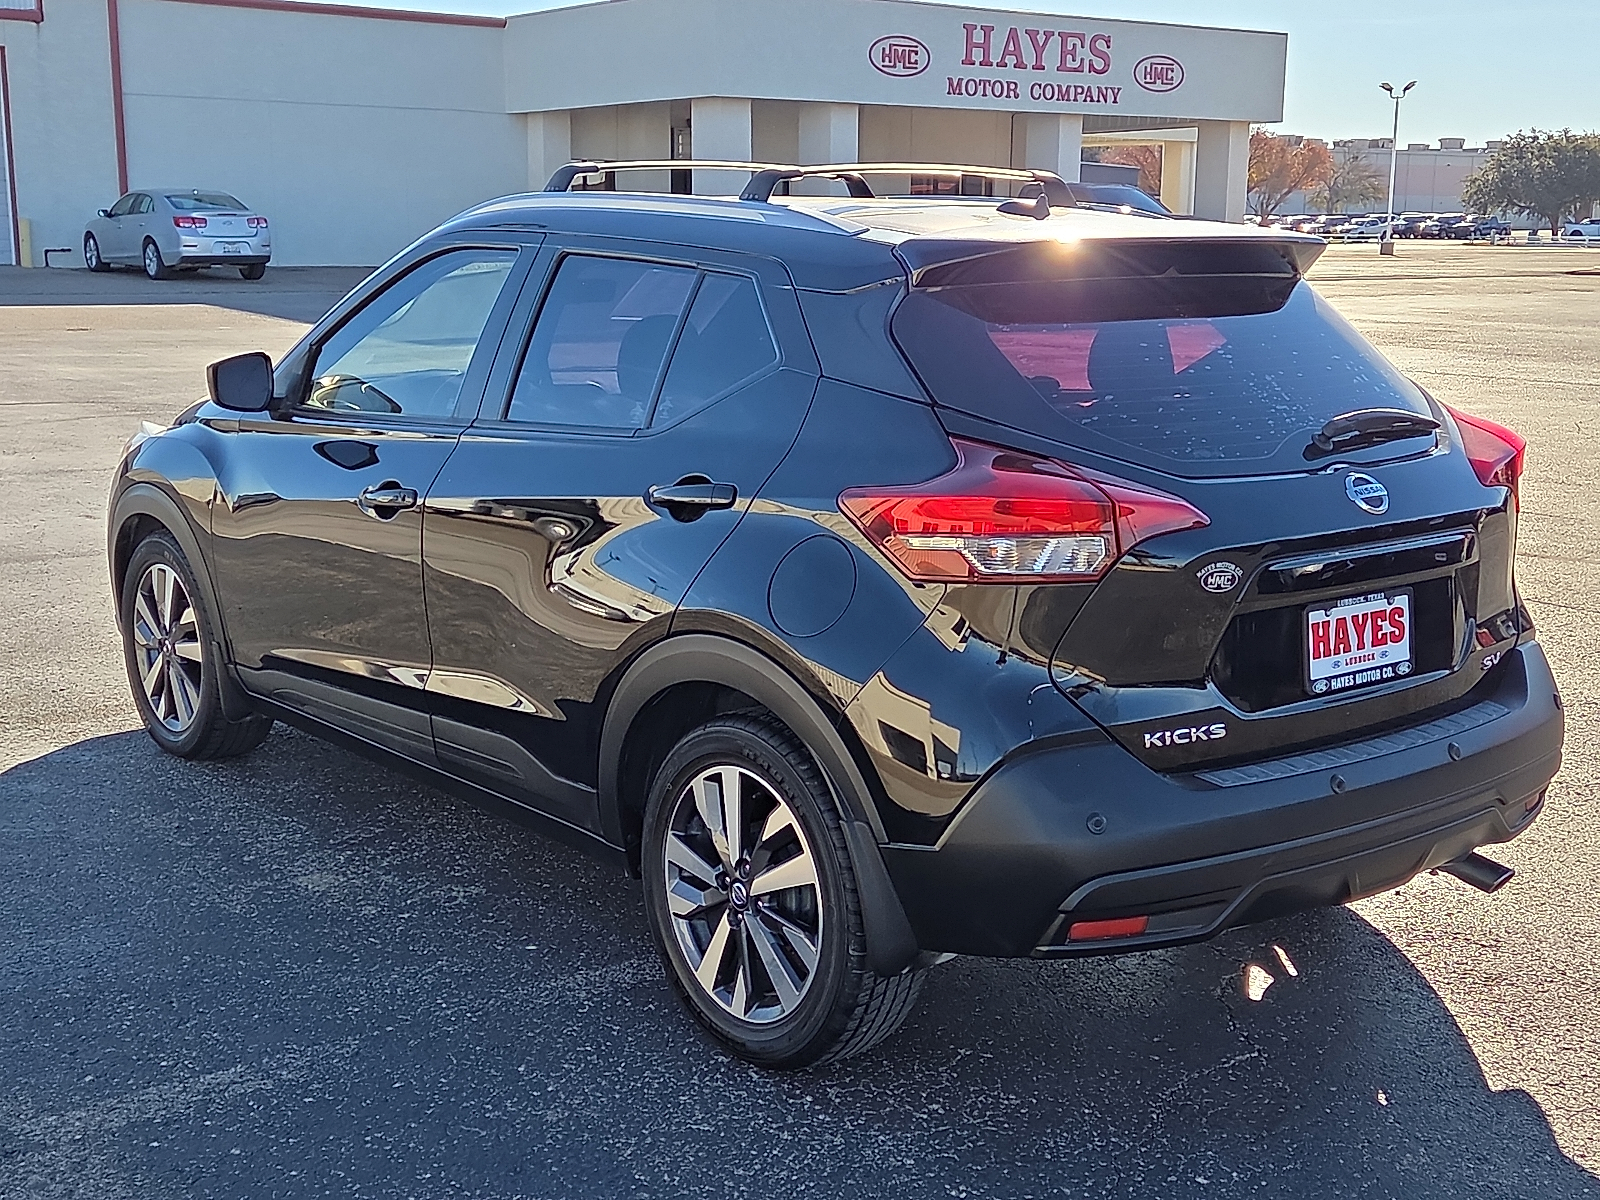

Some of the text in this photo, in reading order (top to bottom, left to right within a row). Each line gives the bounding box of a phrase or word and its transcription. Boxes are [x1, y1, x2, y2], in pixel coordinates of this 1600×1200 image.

[961, 23, 1112, 74] HAYES
[947, 77, 1122, 105] MOTOR COMPANY
[1353, 485, 1386, 497] NISSAN
[1311, 606, 1406, 660] HAYES
[1344, 653, 1376, 667] LUBBOCK
[1481, 651, 1501, 671] SV
[1331, 675, 1354, 690] HAYES
[1355, 668, 1382, 684] MOTOR
[1382, 666, 1395, 678] CO.
[1143, 723, 1226, 749] KICKS
